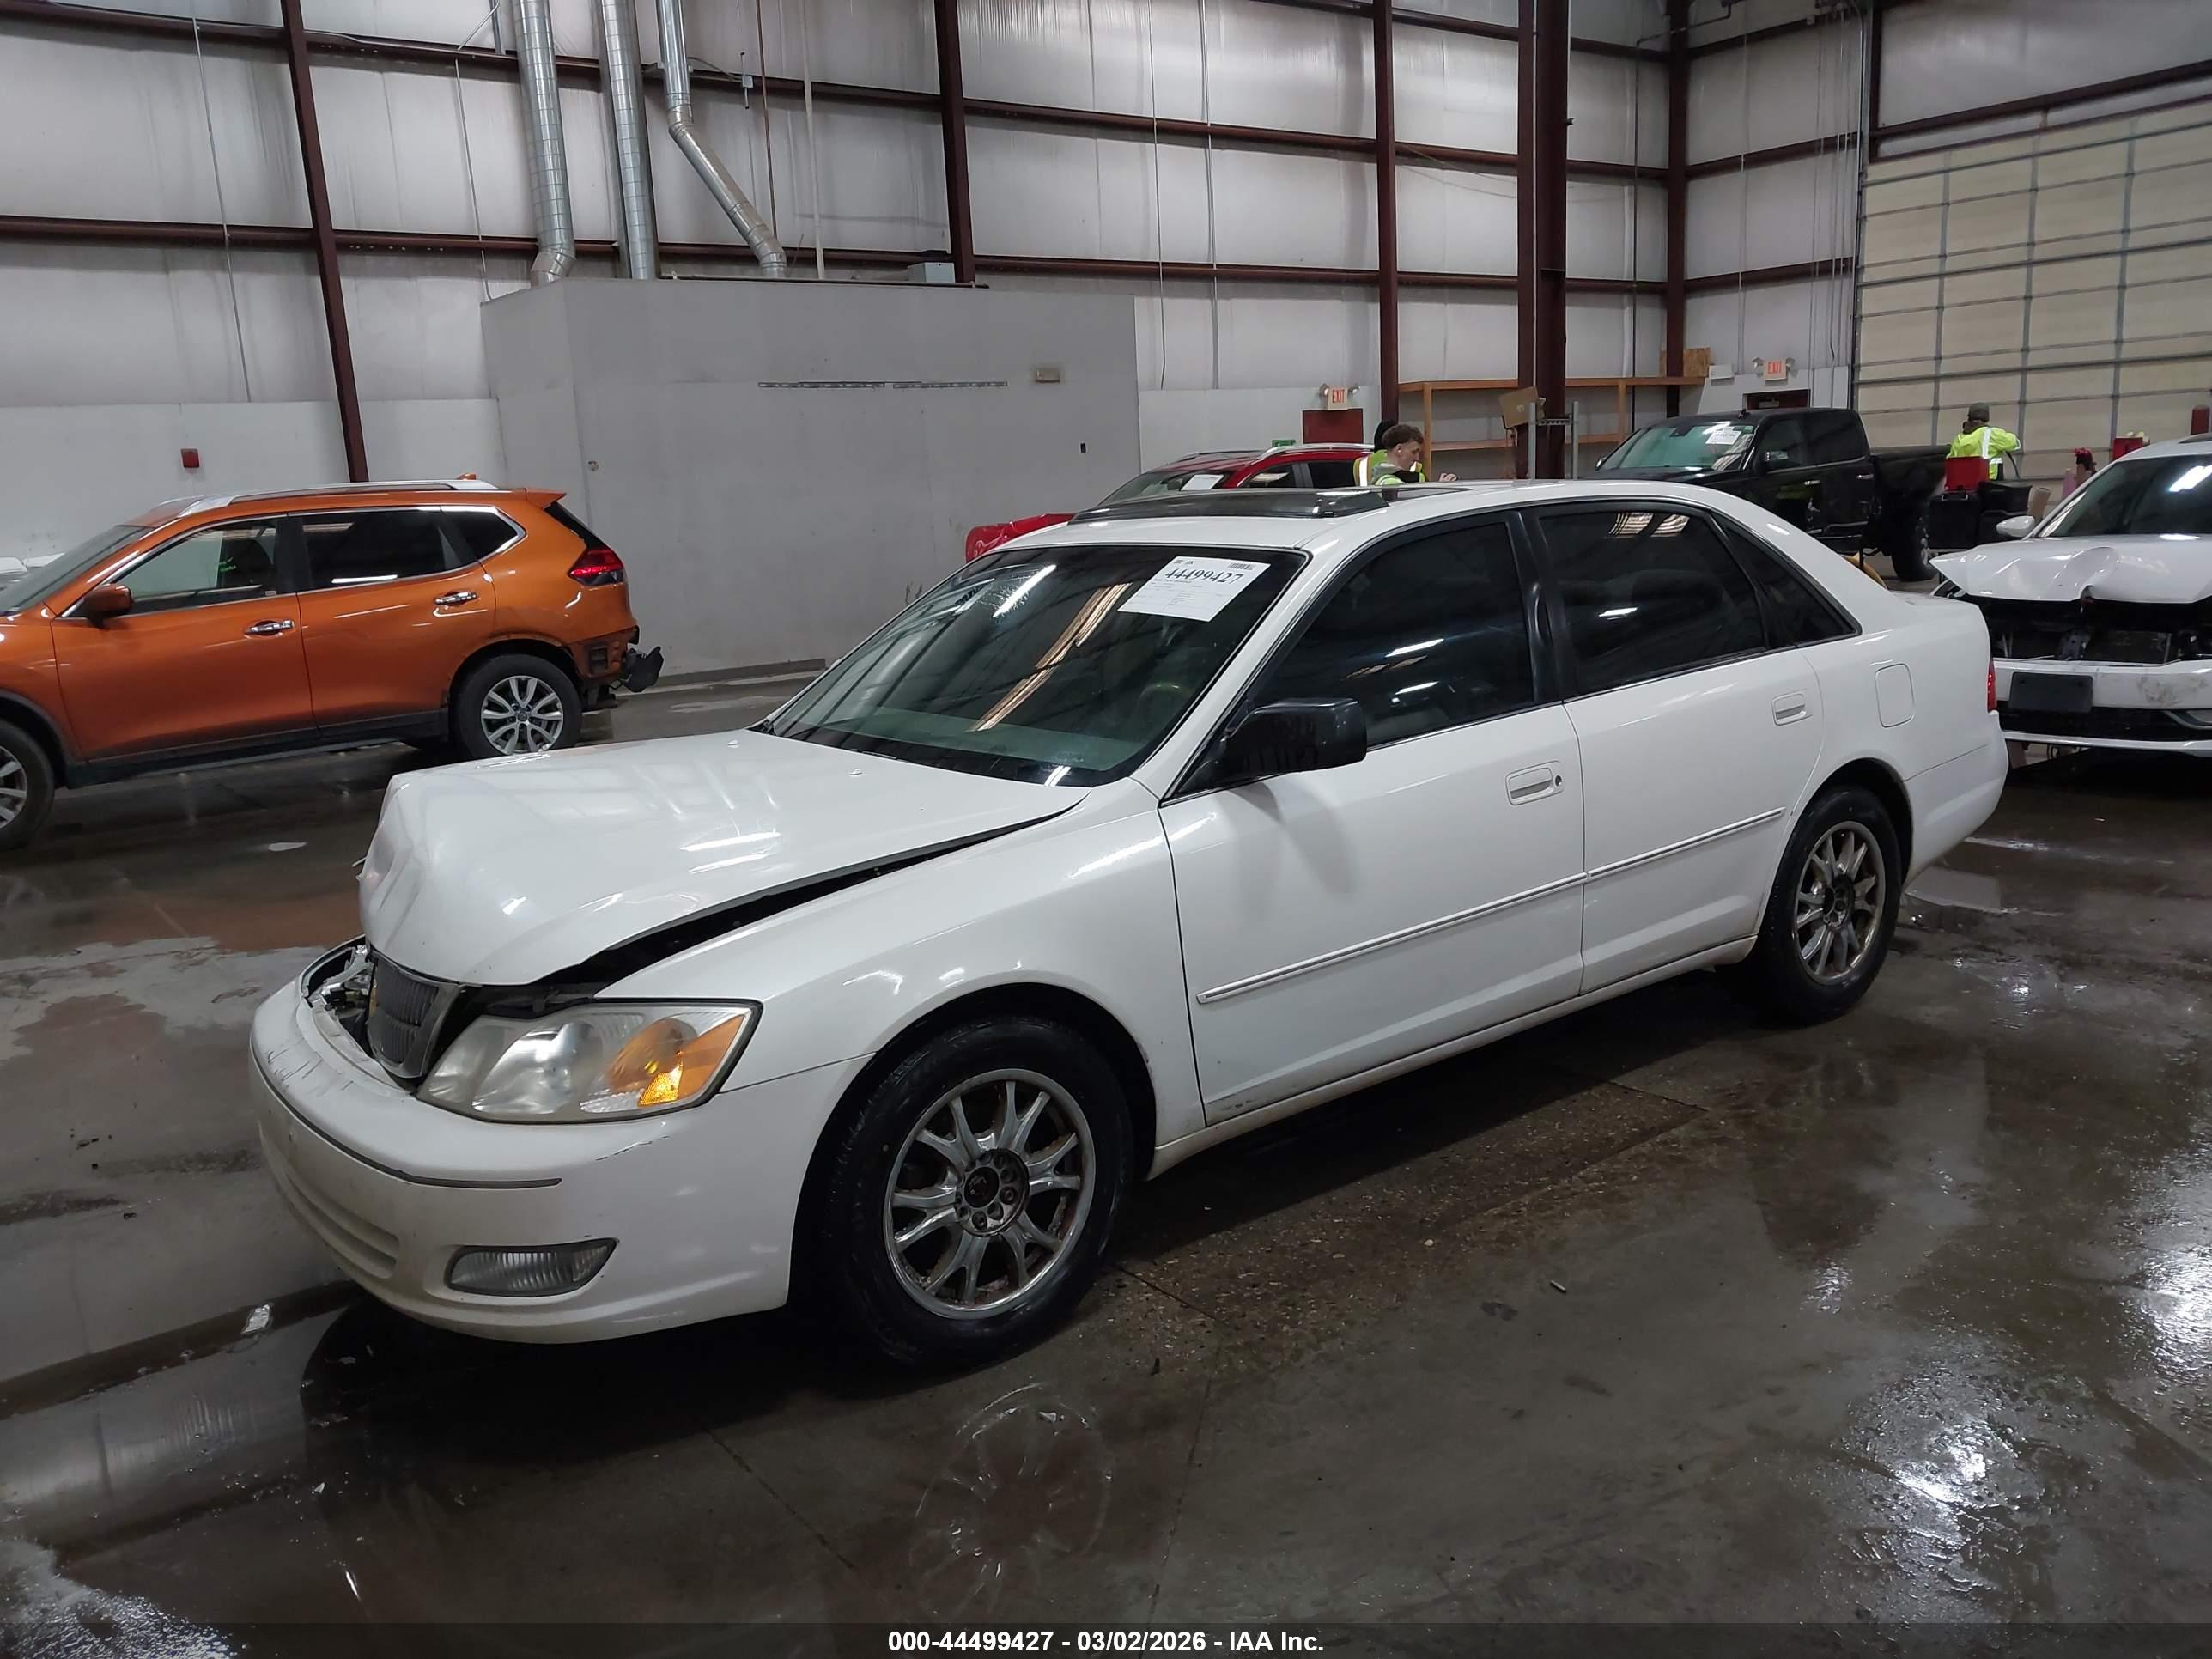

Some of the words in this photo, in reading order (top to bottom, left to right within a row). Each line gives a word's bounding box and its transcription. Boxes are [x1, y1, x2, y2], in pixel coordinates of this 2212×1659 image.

[1768, 362, 1783, 374] EXIT
[1332, 389, 1346, 403] EXIT
[1165, 568, 1243, 584] 44499427
